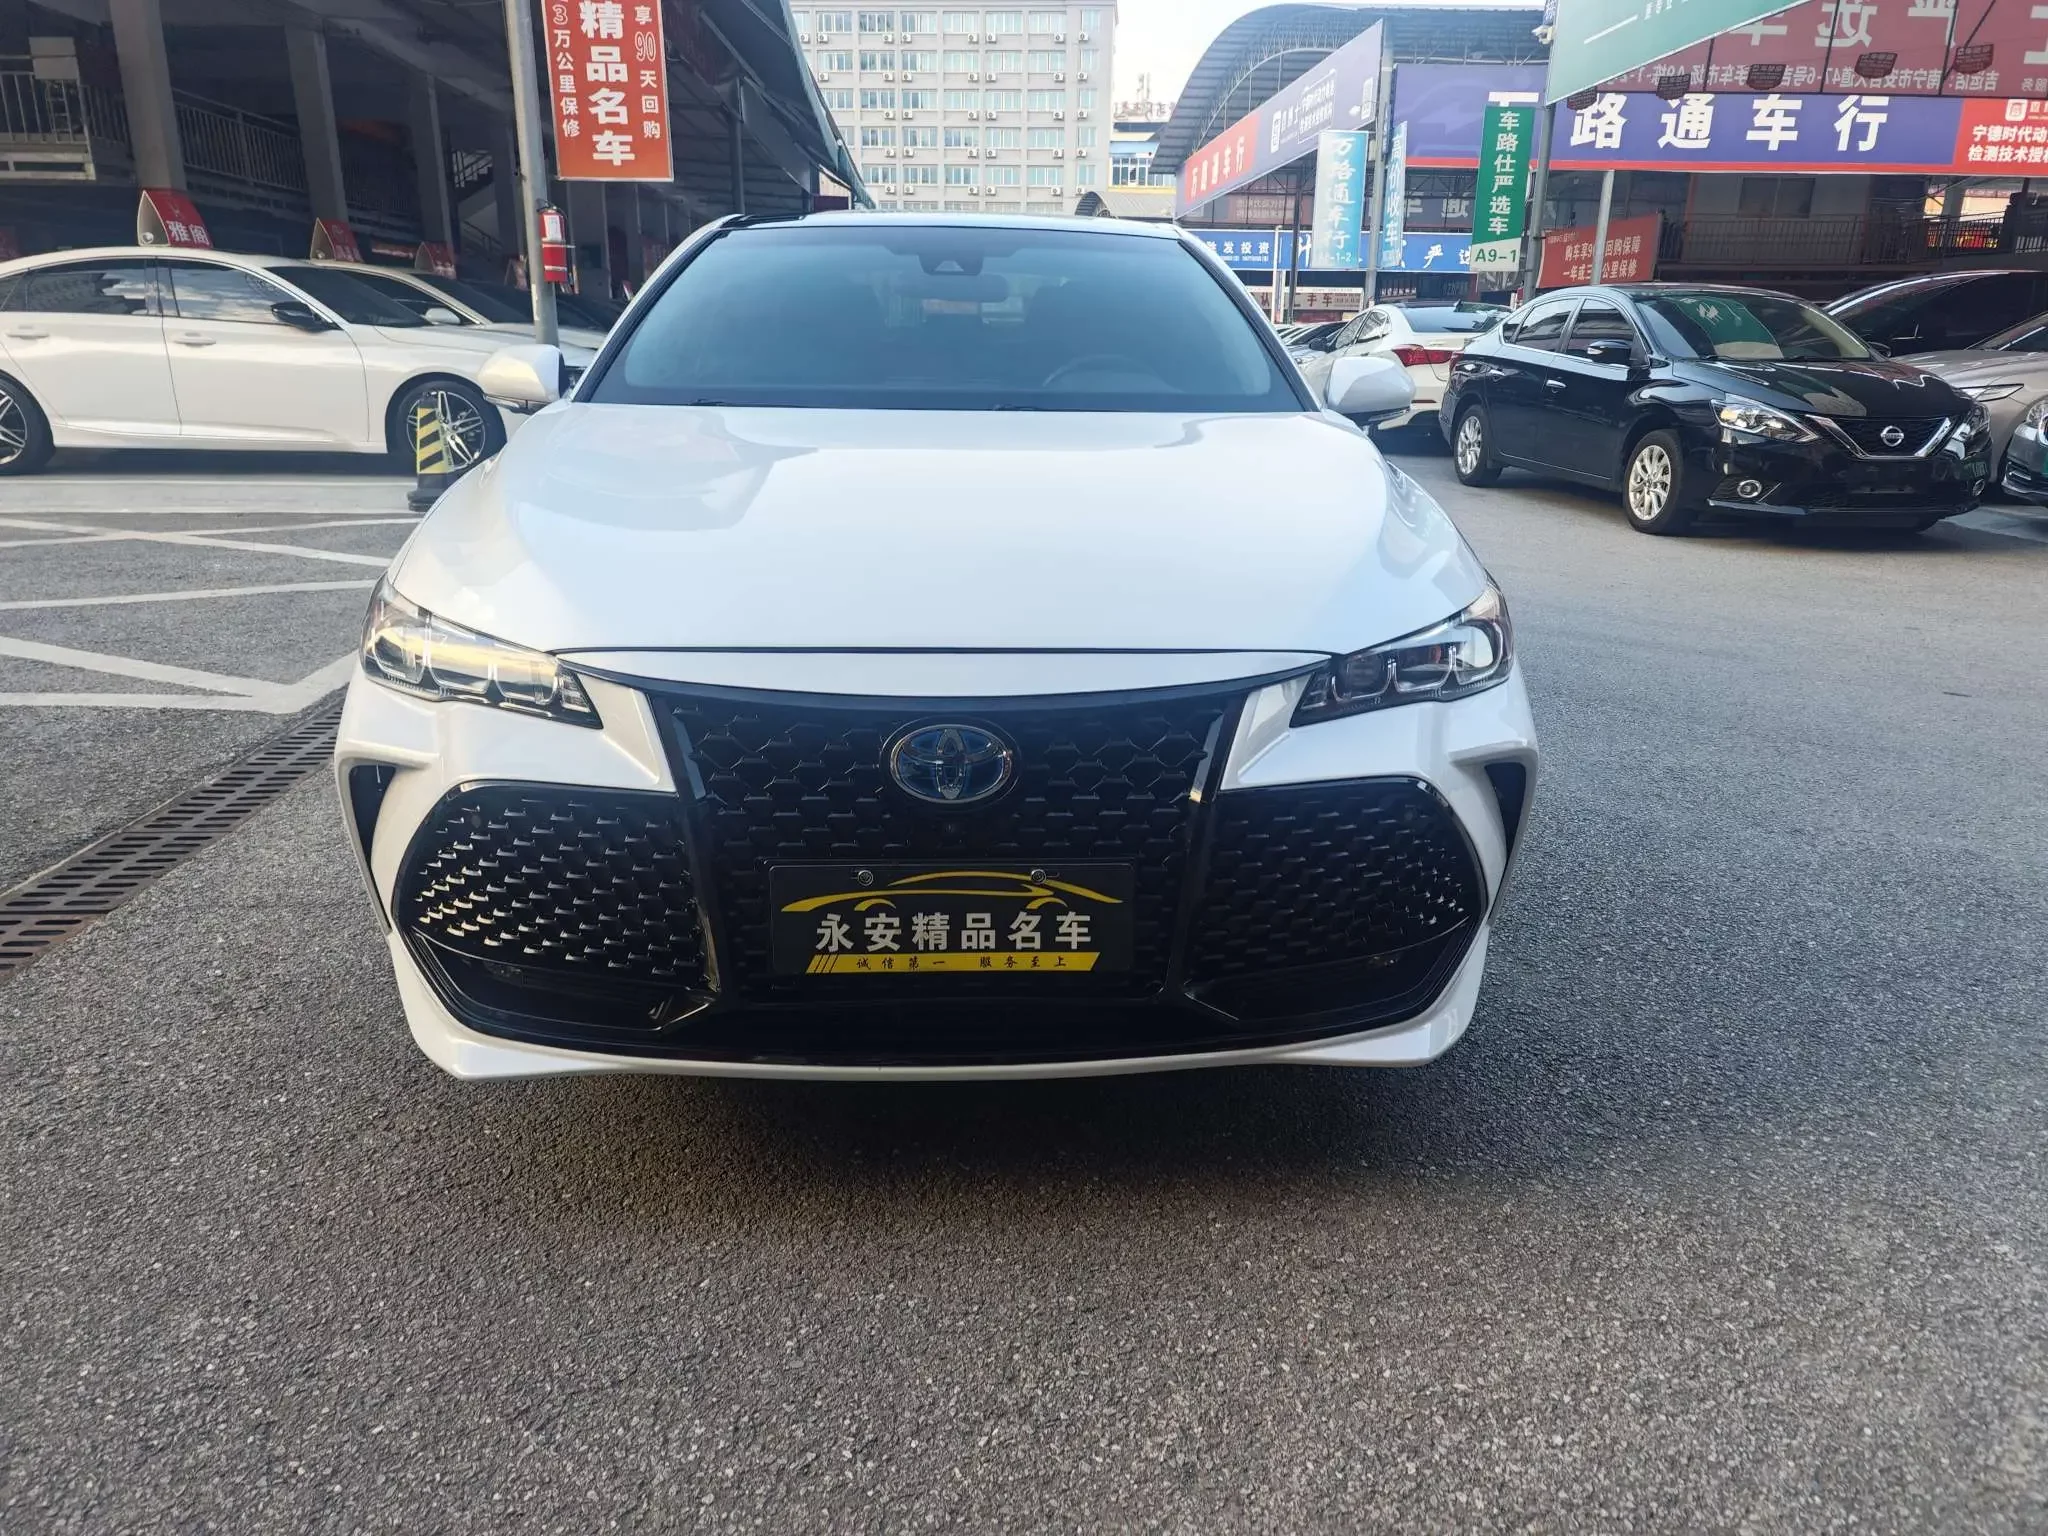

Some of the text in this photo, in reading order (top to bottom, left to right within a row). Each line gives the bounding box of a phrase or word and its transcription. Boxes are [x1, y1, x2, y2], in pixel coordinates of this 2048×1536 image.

[579, 0, 635, 166] 精品名车
[1488, 92, 1888, 151] 路通车行
[1488, 111, 1520, 235] 车路仕严选车
[1474, 248, 1517, 263] A9-1
[1565, 235, 1641, 261] 购车享9回购保障
[1562, 259, 1637, 282] 一年或三公里保修
[815, 911, 1092, 952] 永安精品名车
[856, 955, 1067, 971] 诚信第一 服务至上
